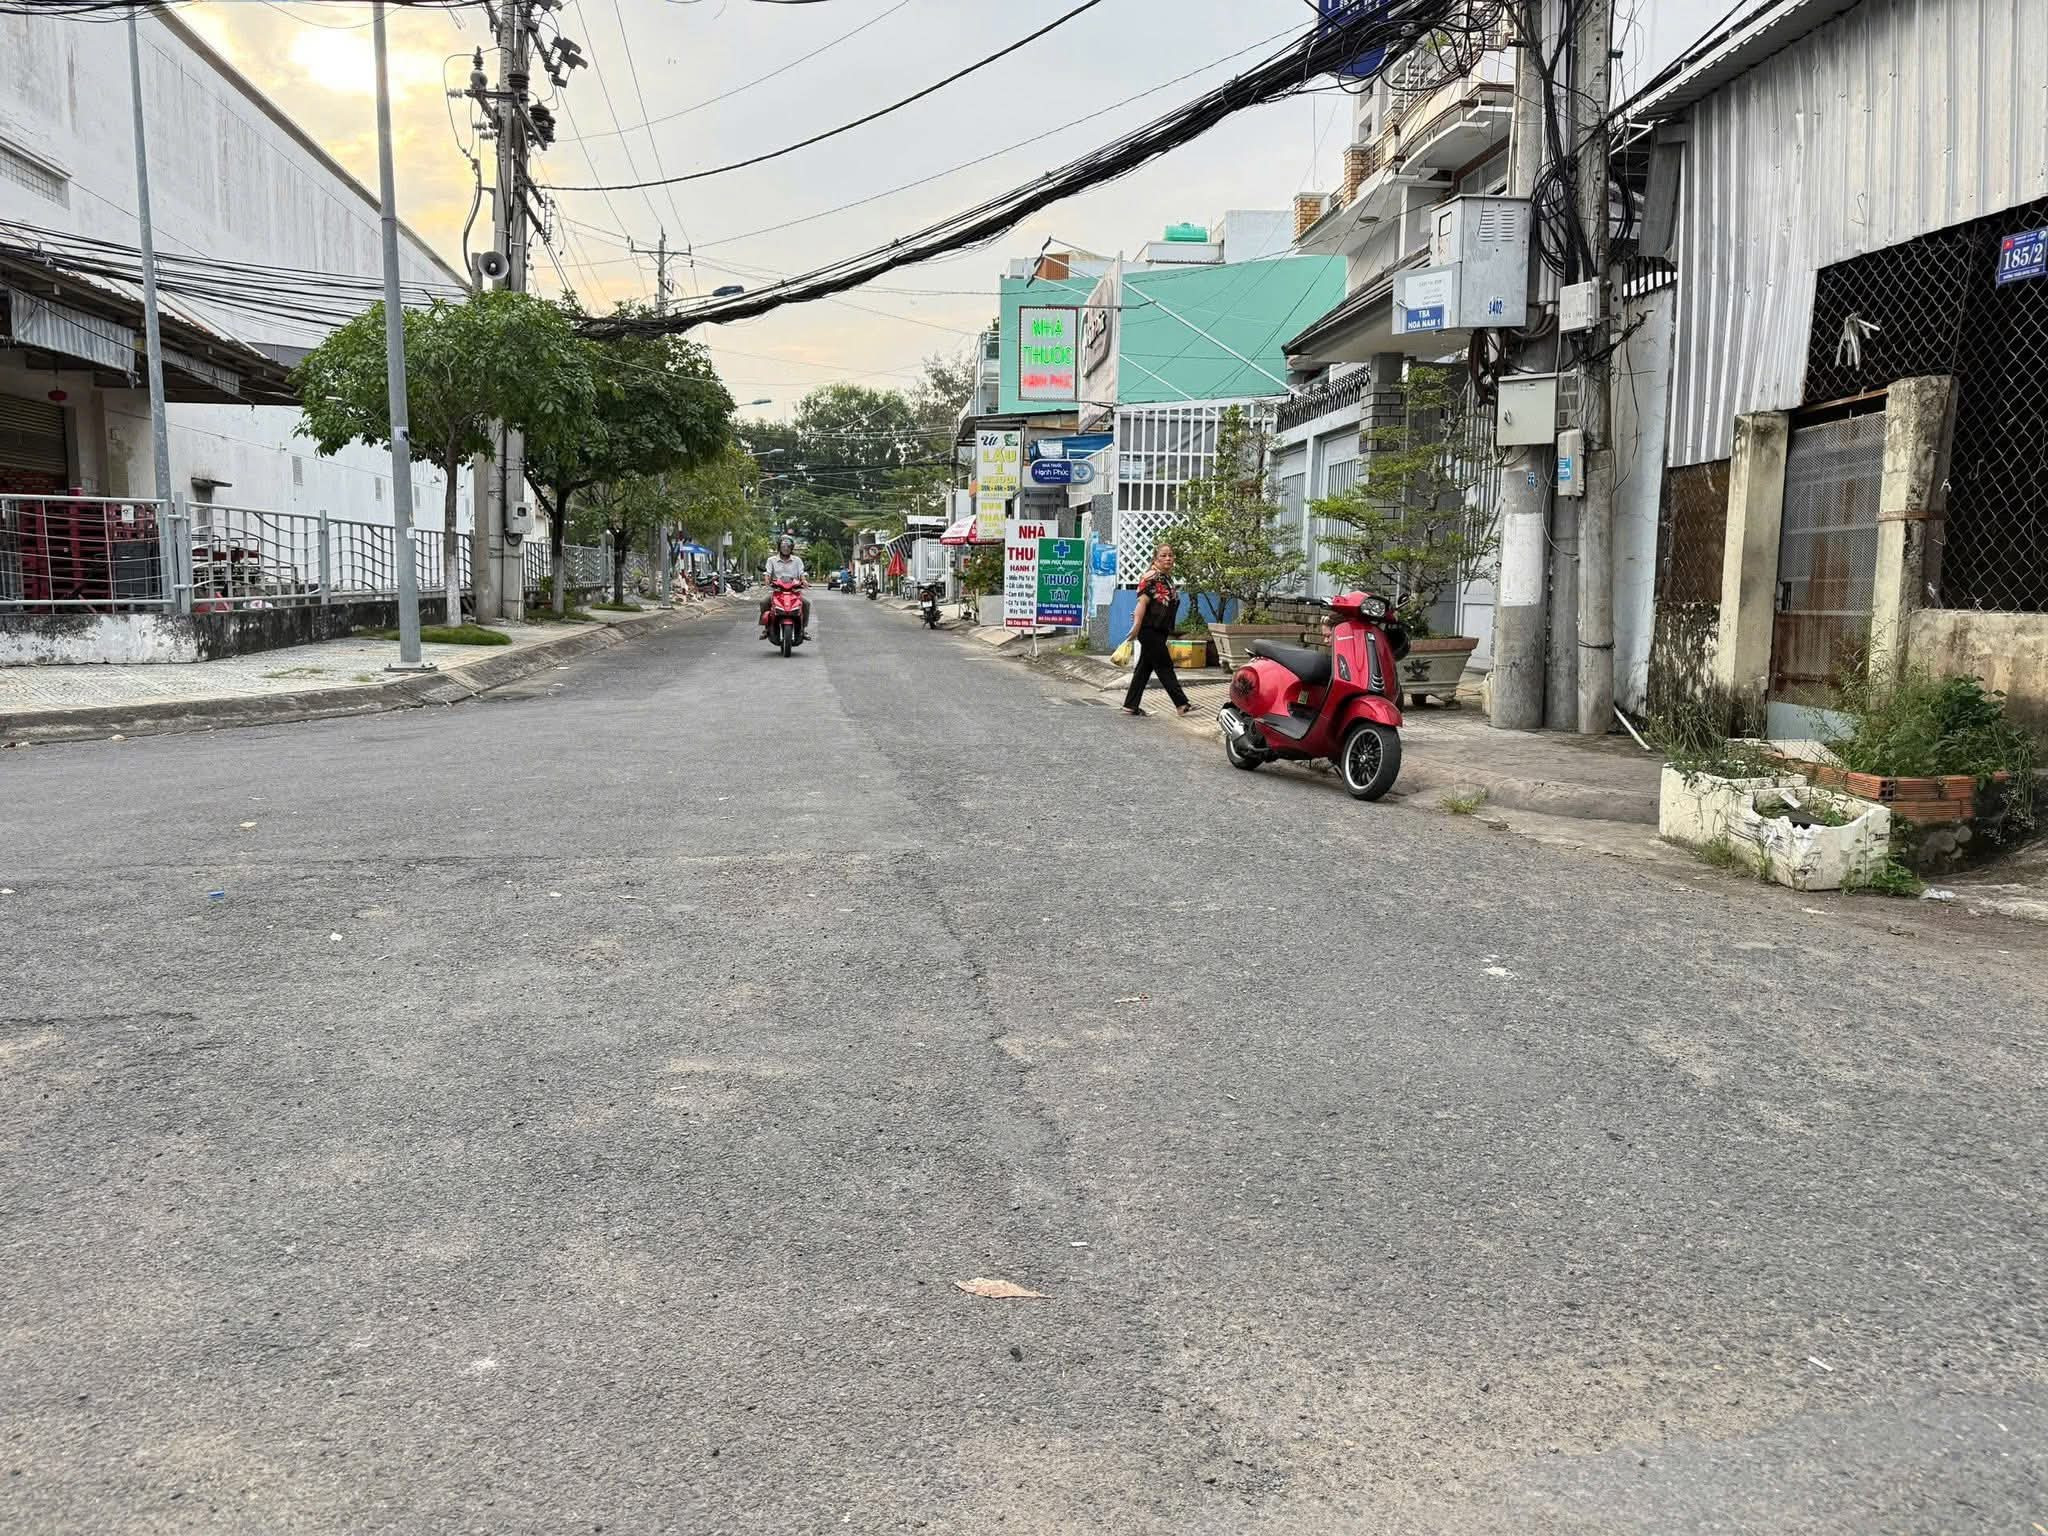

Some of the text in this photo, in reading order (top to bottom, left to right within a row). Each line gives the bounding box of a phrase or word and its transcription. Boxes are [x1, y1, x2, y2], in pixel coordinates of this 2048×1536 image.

[2003, 242, 2043, 270] 185/2
[1418, 310, 1430, 318] TBA
[1032, 313, 1064, 337] NHÀ
[1422, 318, 1436, 328] NAM
[1019, 522, 1046, 538] NHÀ
[1008, 547, 1036, 560] THU
[1043, 570, 1079, 586] THUỐC
[1049, 587, 1070, 602] TÂY
